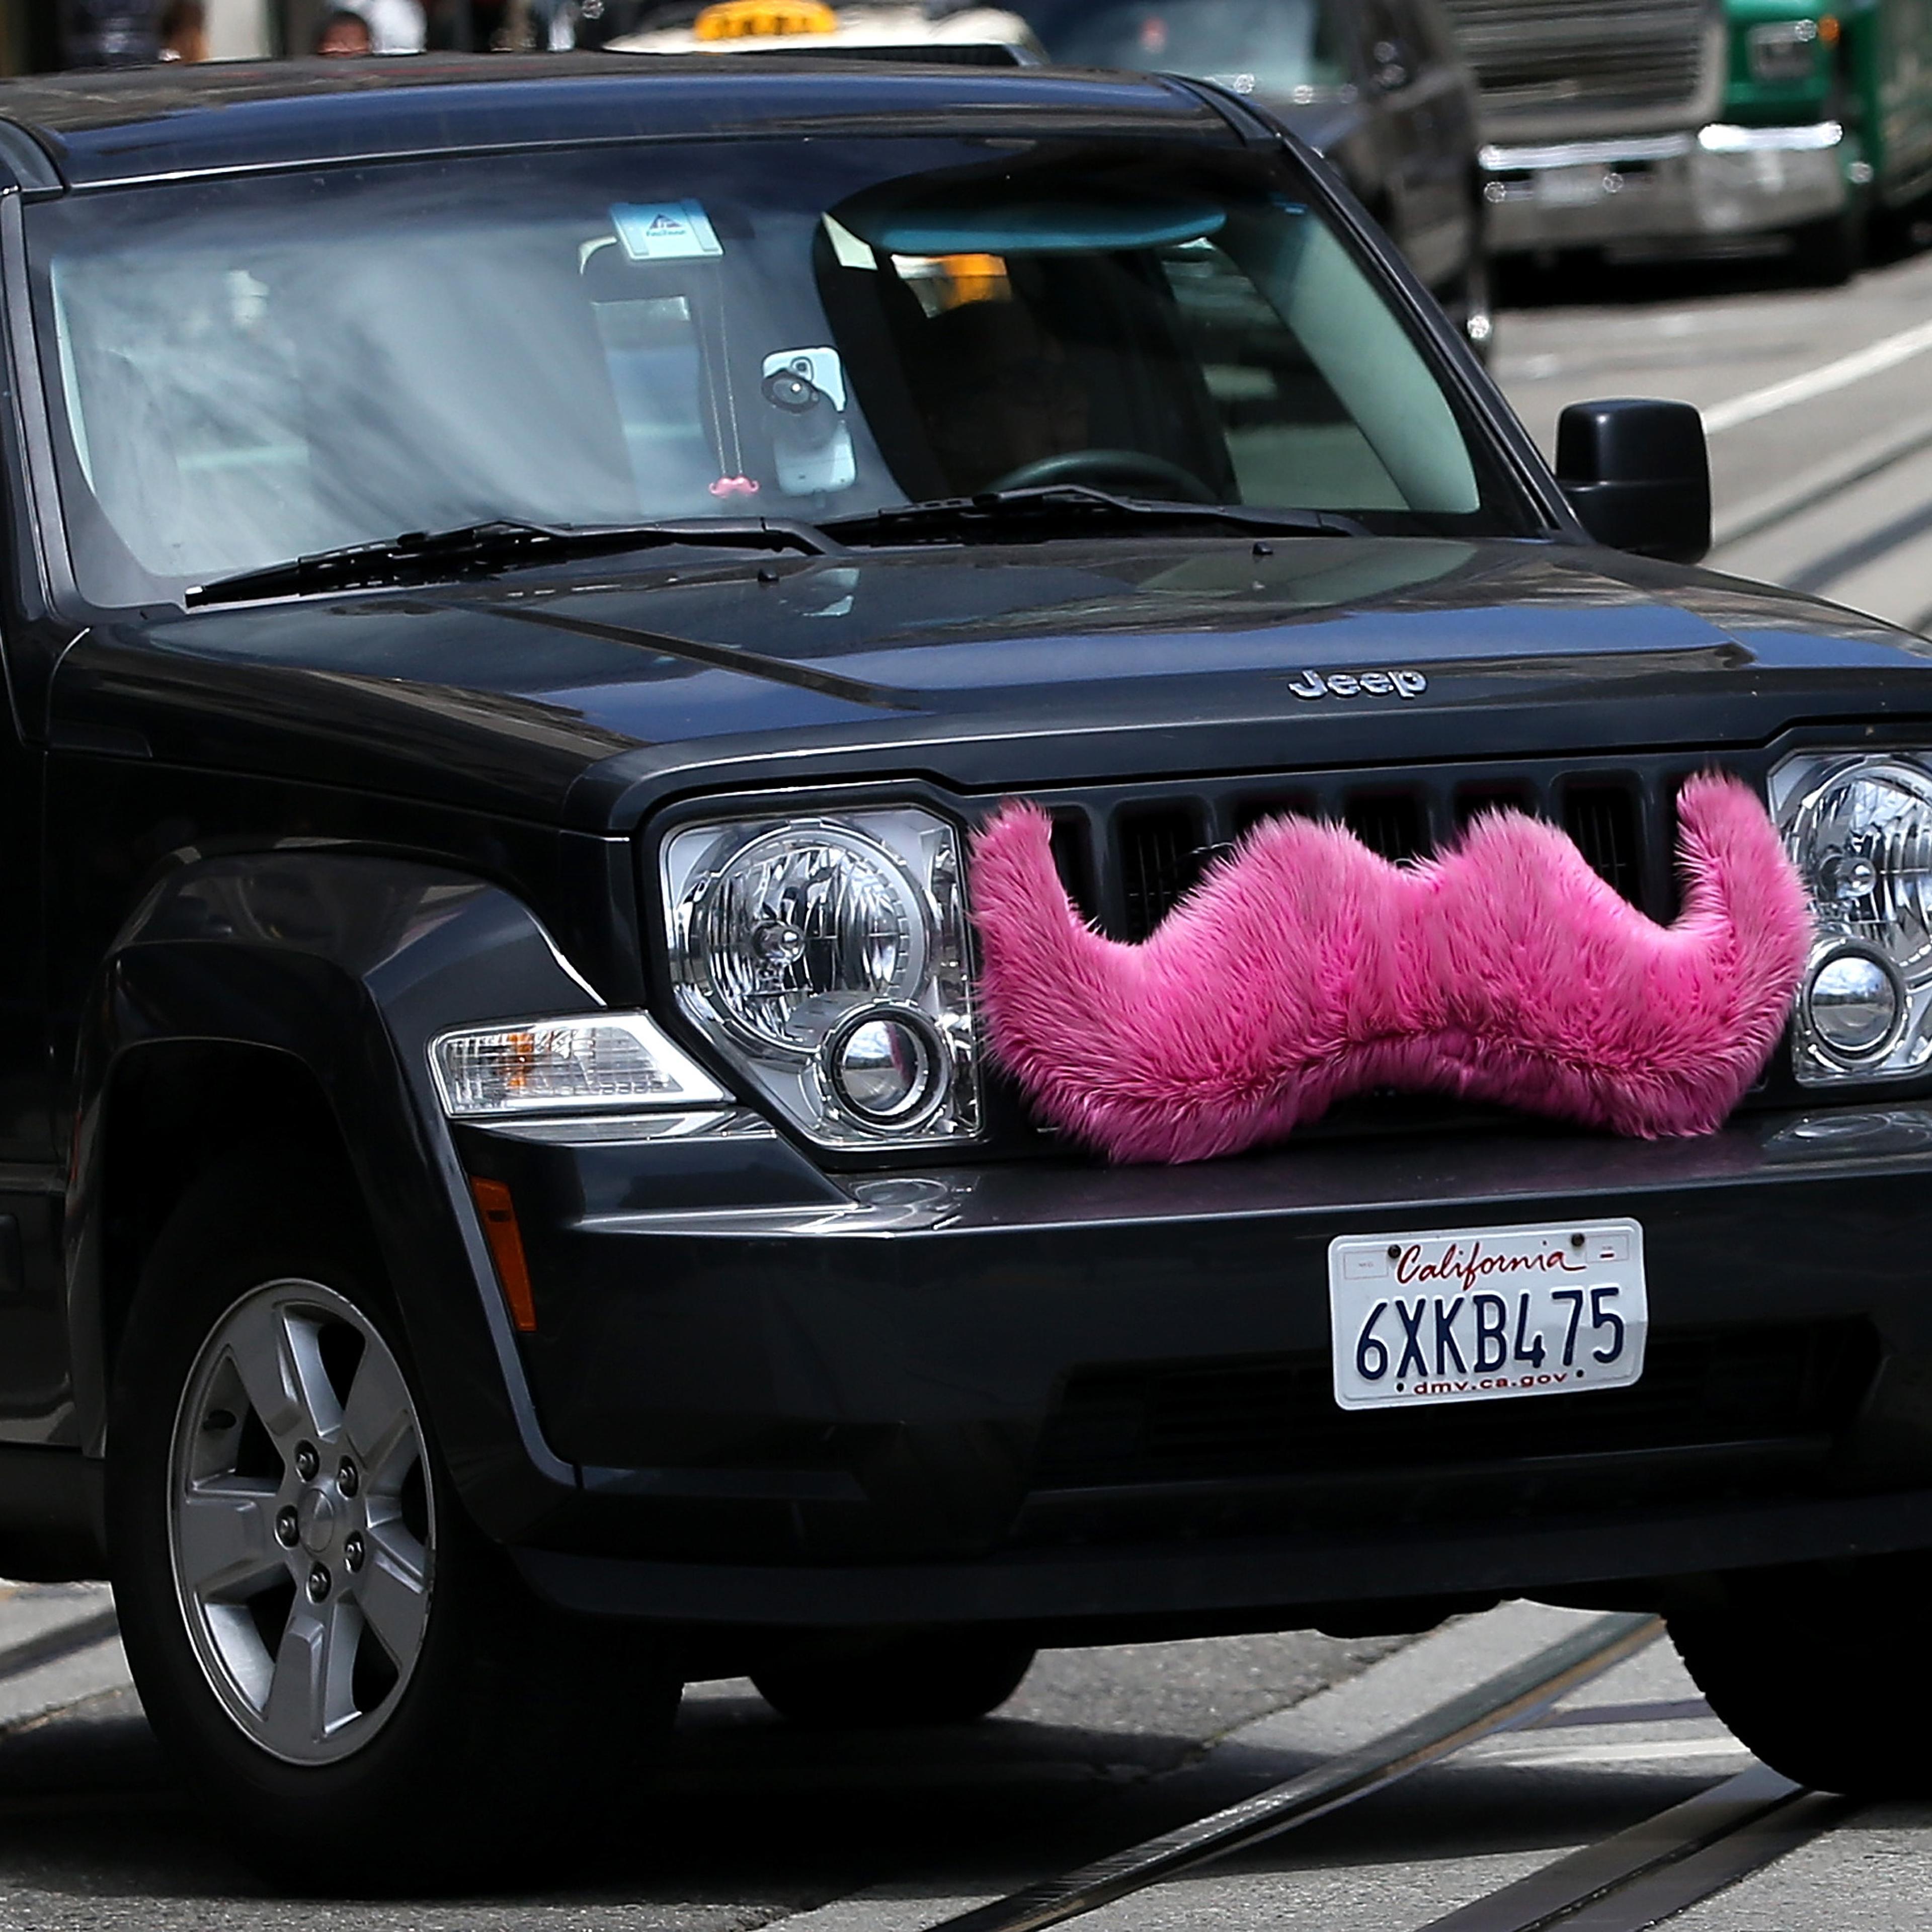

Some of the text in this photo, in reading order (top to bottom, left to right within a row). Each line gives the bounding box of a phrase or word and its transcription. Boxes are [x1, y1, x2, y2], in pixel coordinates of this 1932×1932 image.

[1287, 670, 1427, 699] Jeep
[1396, 1241, 1587, 1291] California
[1357, 1286, 1624, 1381] 6XKB475
[1413, 1372, 1568, 1395] dmv.ca.gov
